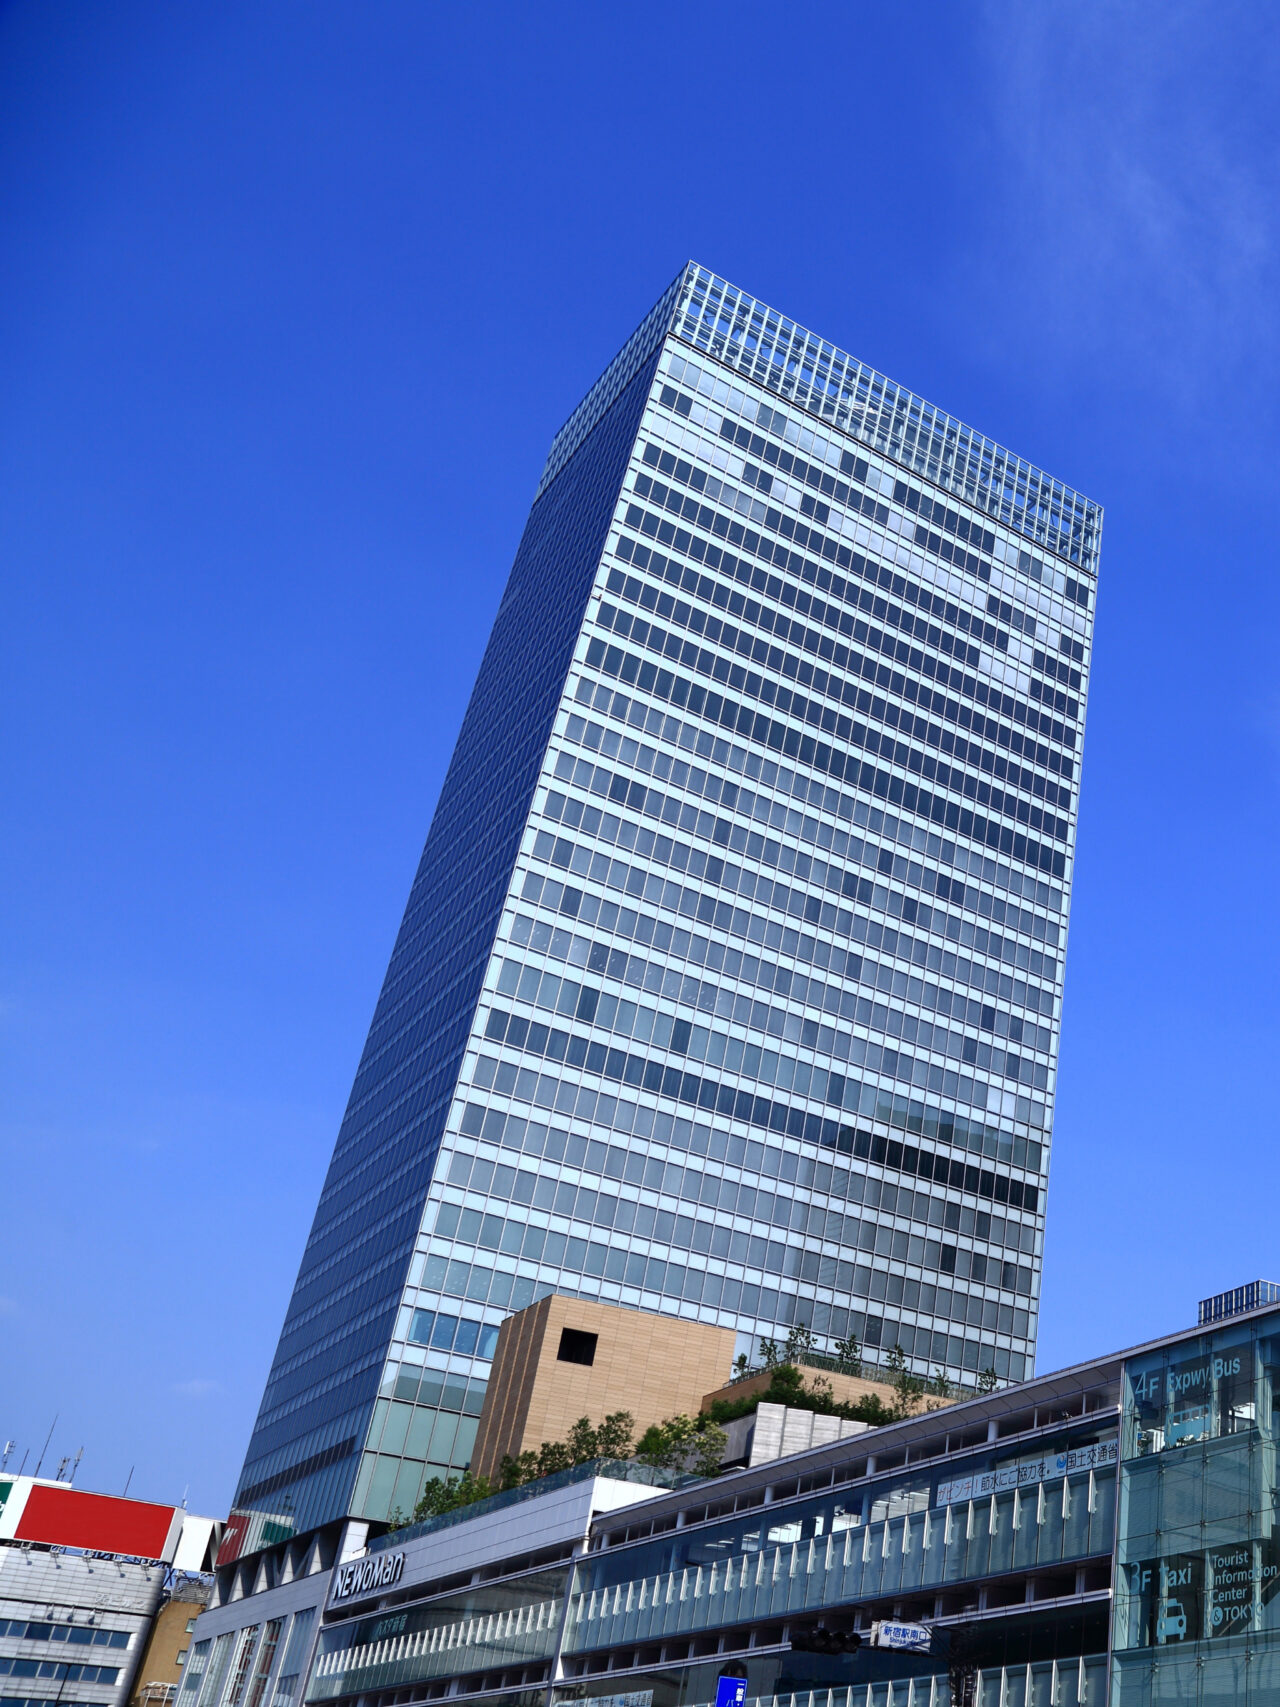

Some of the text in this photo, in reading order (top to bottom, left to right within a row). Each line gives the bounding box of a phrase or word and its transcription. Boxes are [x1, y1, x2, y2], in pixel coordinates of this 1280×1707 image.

[1135, 1370, 1160, 1400] 4F
[1213, 1357, 1241, 1380] Bus
[1067, 1444, 1118, 1471] 国土交通省
[1211, 1550, 1249, 1569] Tourist
[332, 1552, 405, 1601] NEWoMan
[1130, 1561, 1152, 1594] 3F
[1211, 1586, 1248, 1604] Center
[883, 1625, 928, 1641] 新宿駅南口
